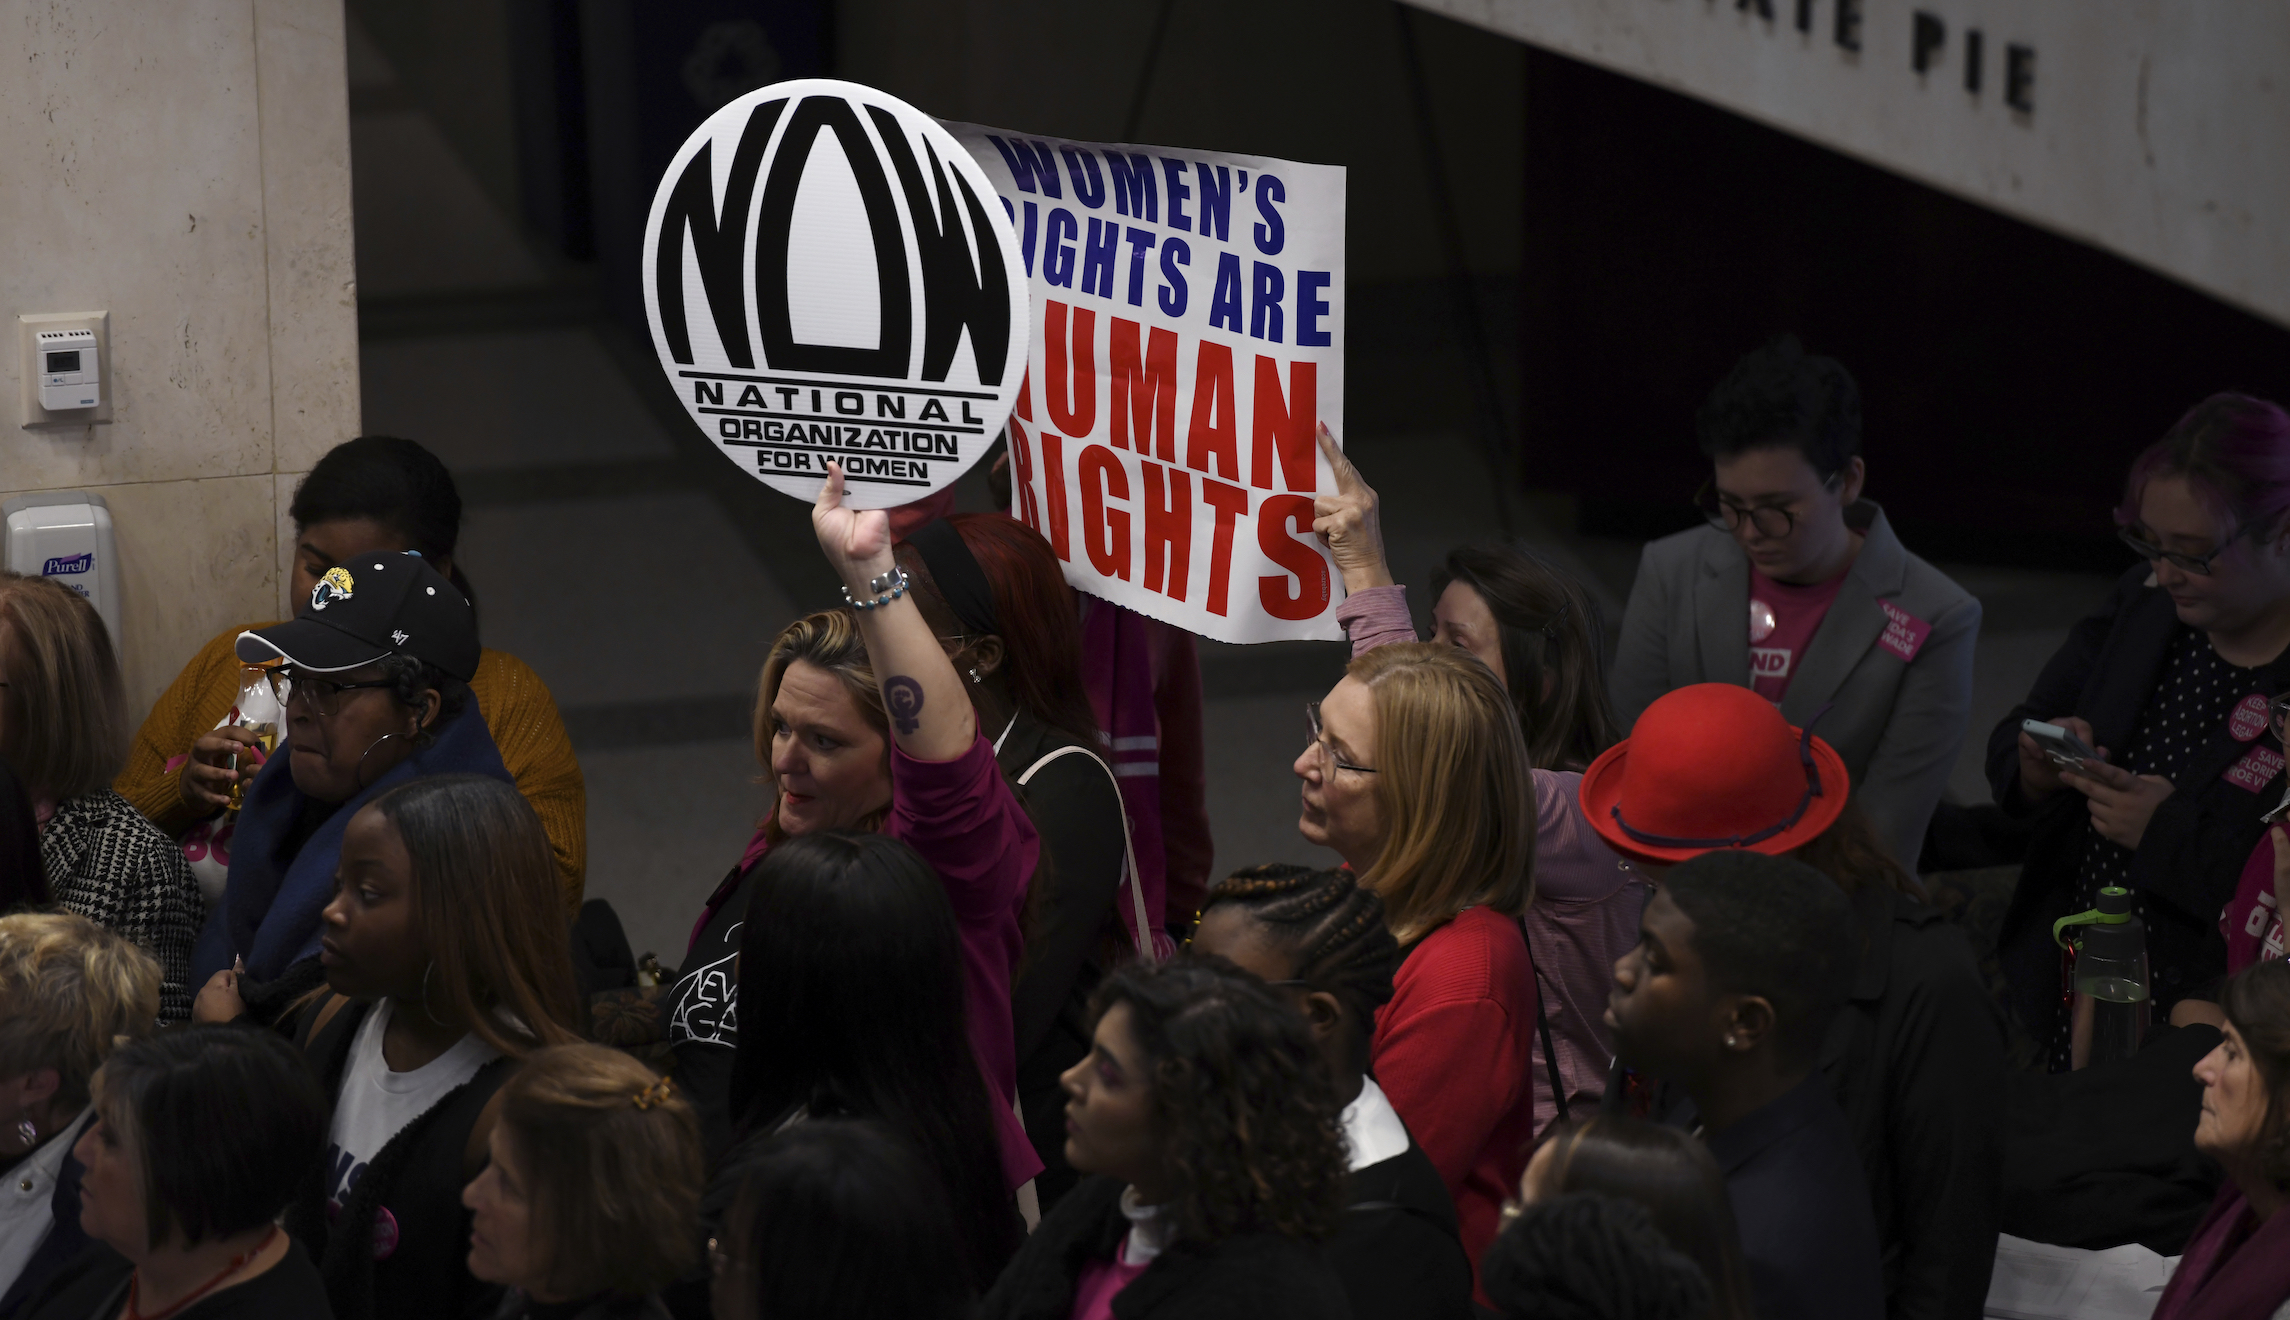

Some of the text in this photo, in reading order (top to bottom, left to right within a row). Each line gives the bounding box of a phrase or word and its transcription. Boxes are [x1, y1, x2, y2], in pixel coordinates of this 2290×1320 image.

[984, 134, 1286, 256] WOMEN'S
[655, 94, 1011, 386] NOW
[999, 195, 1332, 347] IGHTS ARE
[694, 380, 984, 425] NATIONAL
[1012, 298, 1318, 493] UMAN
[719, 418, 958, 455] ORGANIZATION
[757, 450, 928, 479] FOR WOMEN
[1010, 413, 1330, 621] RIGHTS
[46, 558, 88, 574] Purell
[1882, 602, 1911, 627] SAVE
[1881, 630, 1915, 657] WADE
[2232, 704, 2268, 729] ABORTION
[2245, 696, 2267, 711] KEEP
[2231, 720, 2254, 738] LEGAL
[2239, 756, 2278, 779] FLORID
[2257, 750, 2286, 770] SAVE
